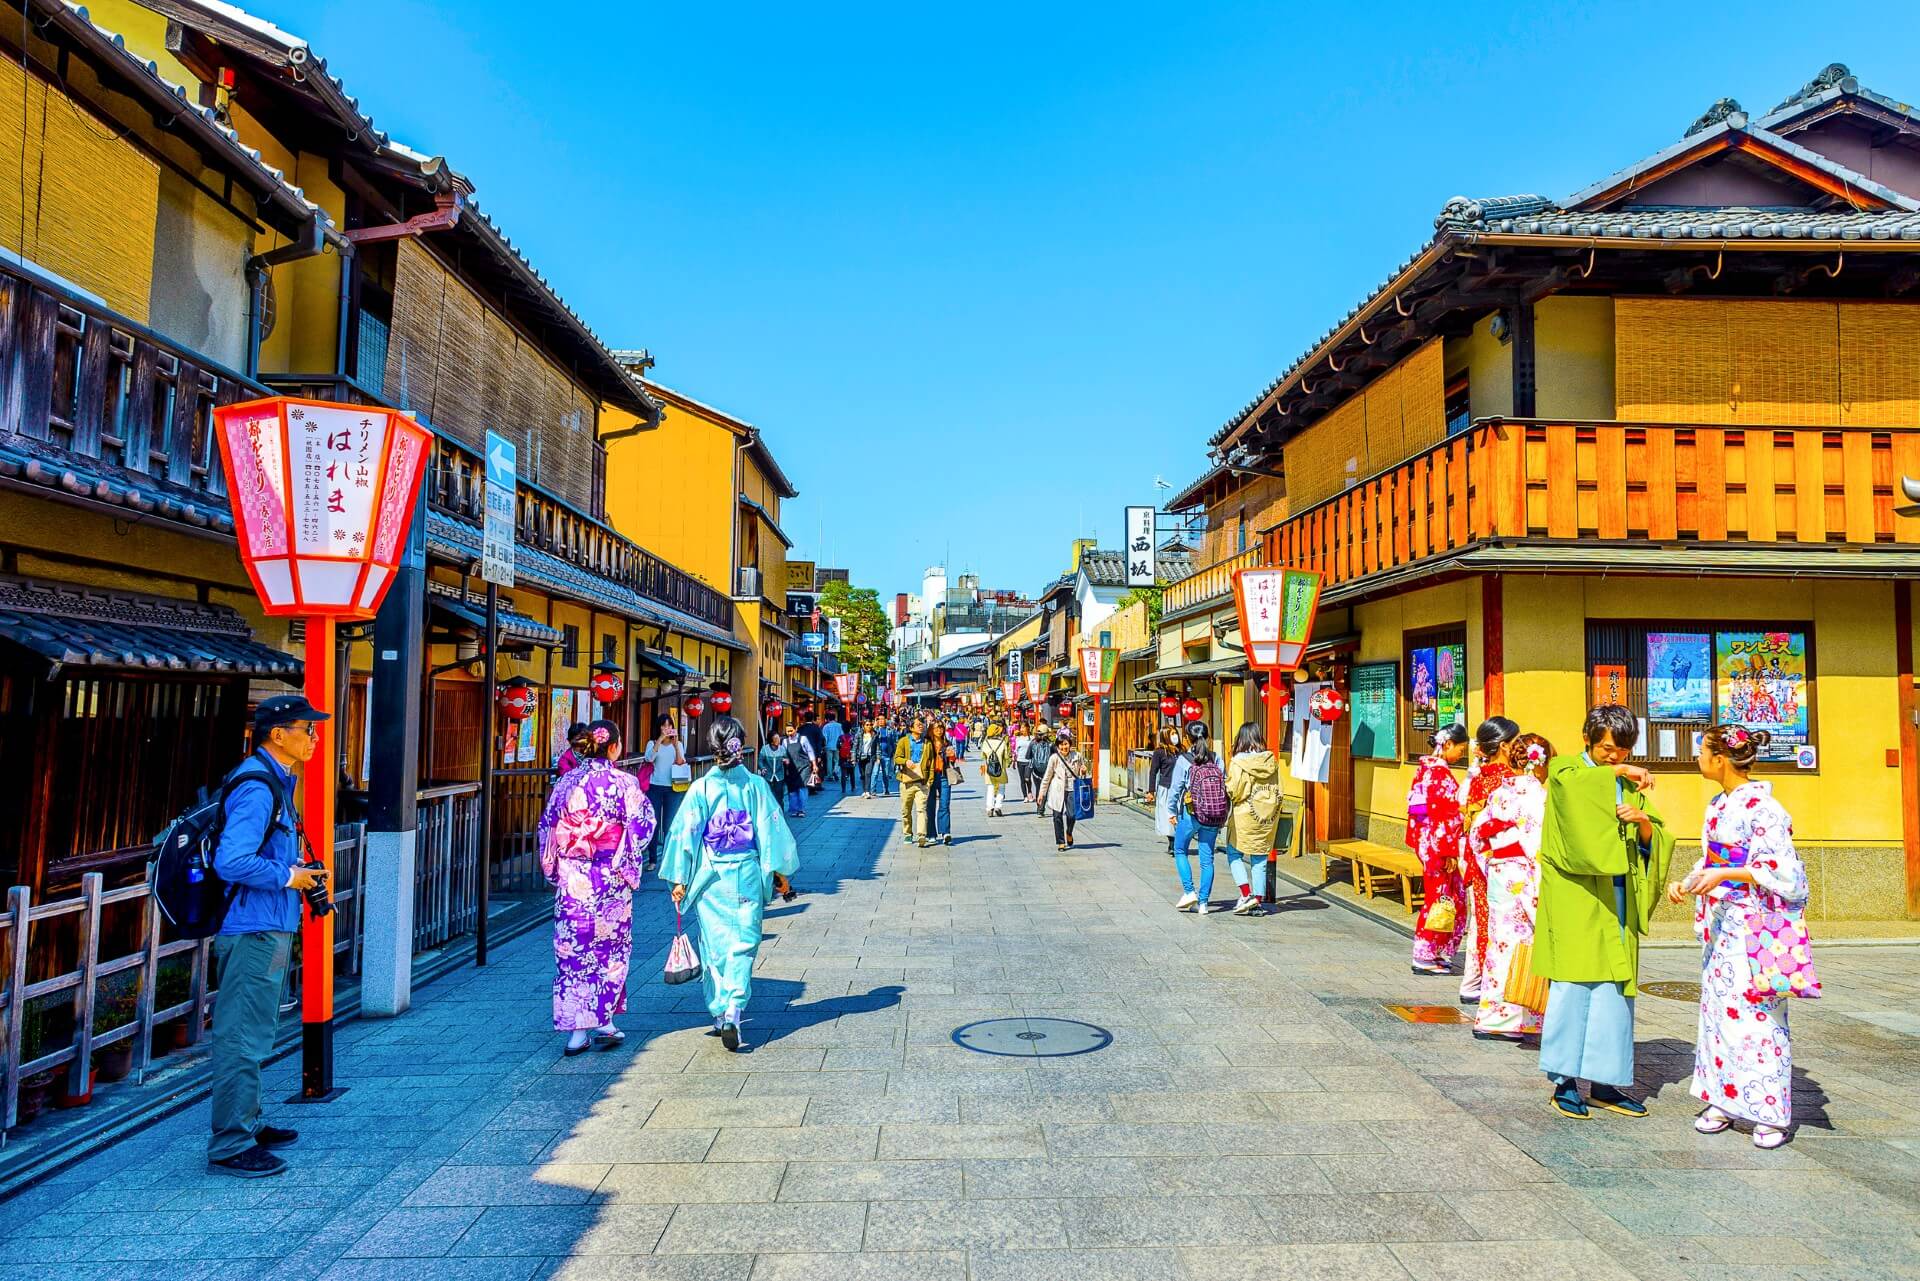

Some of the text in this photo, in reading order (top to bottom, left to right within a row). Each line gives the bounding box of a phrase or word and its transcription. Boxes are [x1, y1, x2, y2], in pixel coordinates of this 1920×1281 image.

[249, 417, 264, 492] 都をどり
[326, 428, 351, 513] はれま
[355, 419, 373, 488] チリメン山椒
[1130, 536, 1152, 577] 西坂
[1731, 639, 1793, 656] ワンピース
